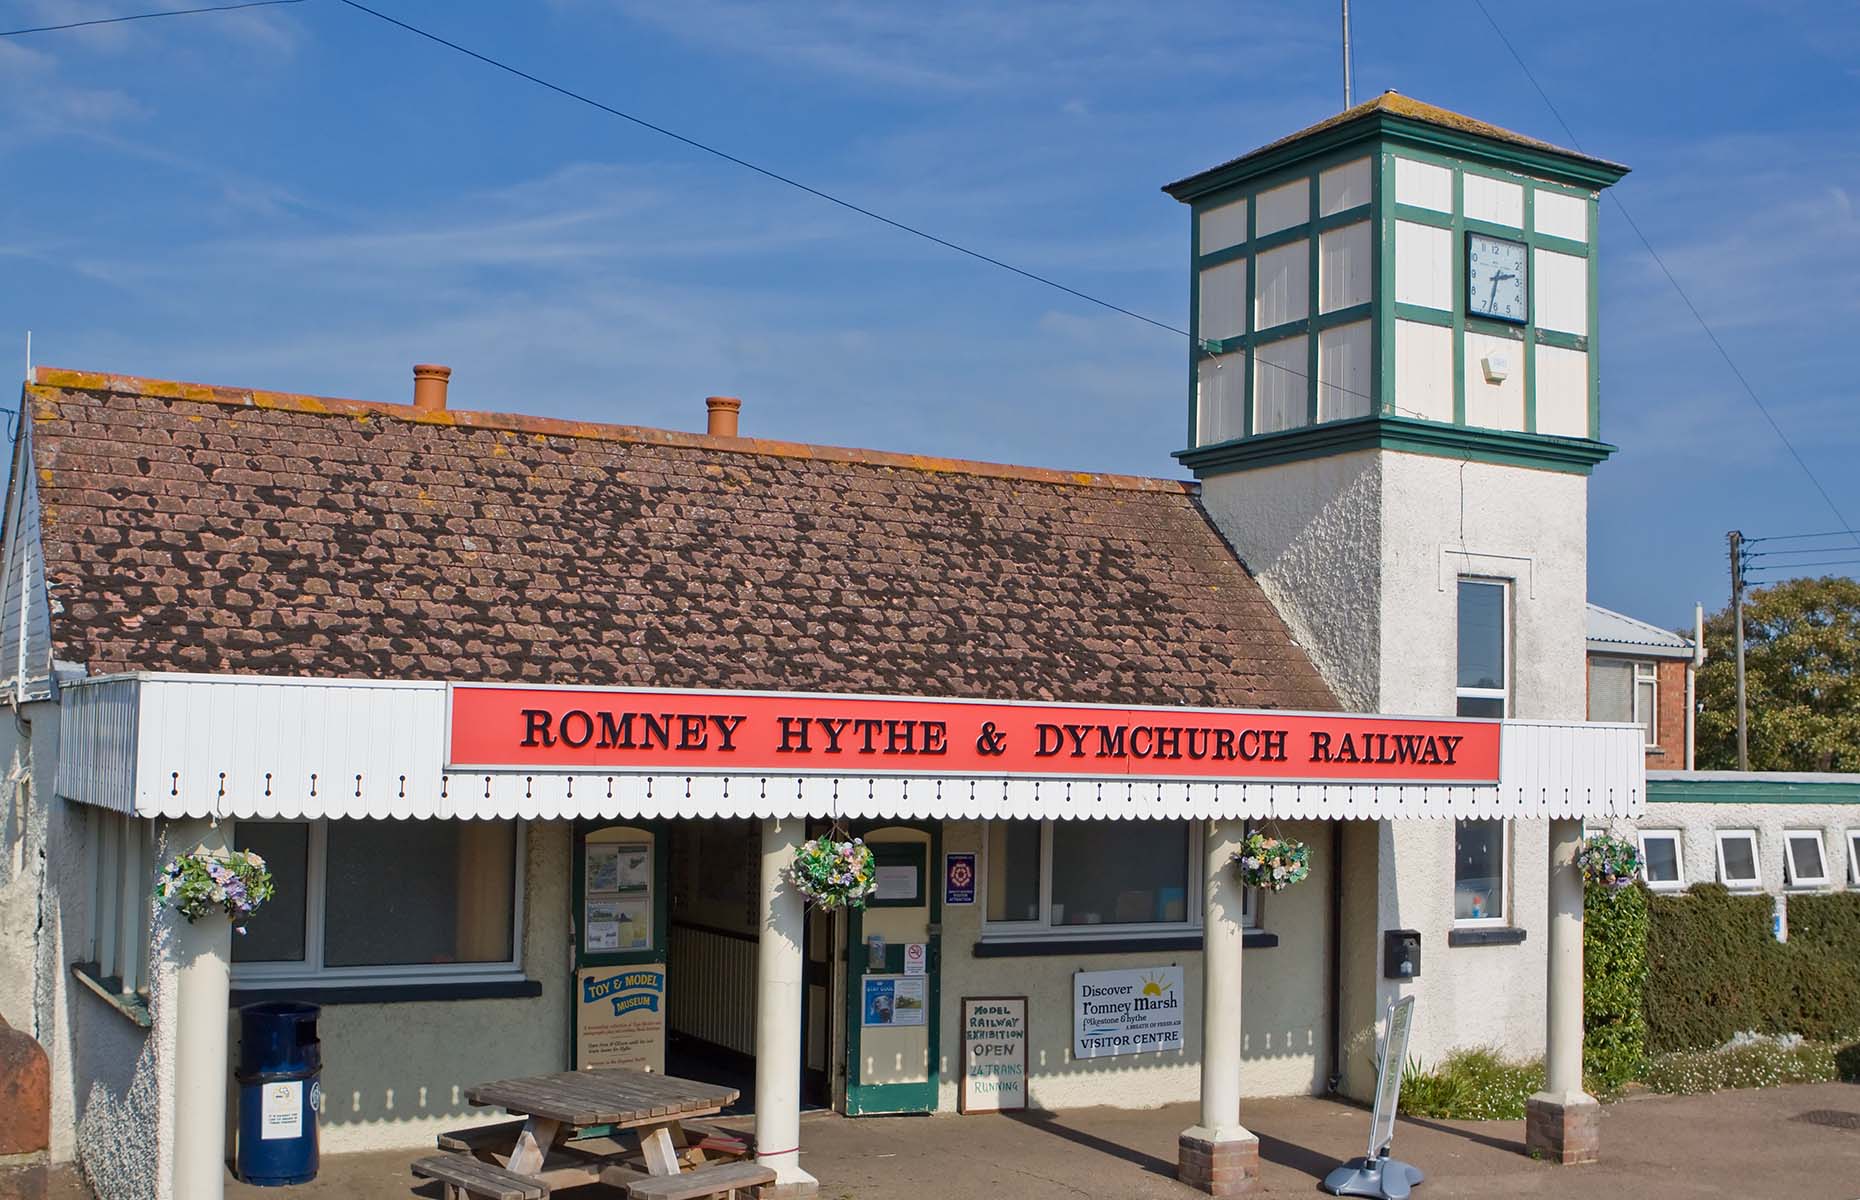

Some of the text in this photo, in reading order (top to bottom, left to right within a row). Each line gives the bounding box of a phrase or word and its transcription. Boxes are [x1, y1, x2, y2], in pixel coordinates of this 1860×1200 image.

[1492, 246, 1499, 255] 12
[1514, 262, 1519, 271] 2
[1514, 278, 1519, 287] 3
[1481, 300, 1487, 309] 7
[1493, 302, 1498, 311] 6
[1505, 305, 1511, 314] 5
[520, 710, 1463, 765] ROMNEY HYTHE & DYMCHURCH RAILWAY
[589, 974, 658, 998] TOY & MODEL
[1082, 985, 1133, 997] Discover
[616, 996, 650, 1012] MUSEUM
[1083, 991, 1177, 1015] romney marsh
[974, 1006, 1010, 1016] MODEL
[969, 1017, 1020, 1028] RAILWAY
[1083, 1013, 1147, 1032] folkestone & hythe
[966, 1030, 1024, 1040] EXHIBITION
[1081, 1031, 1179, 1049] VISITOR CENTRE
[973, 1044, 1015, 1056] OPEN
[970, 1064, 1022, 1077] 24 TRAINS
[975, 1081, 1018, 1094] RUNNING
